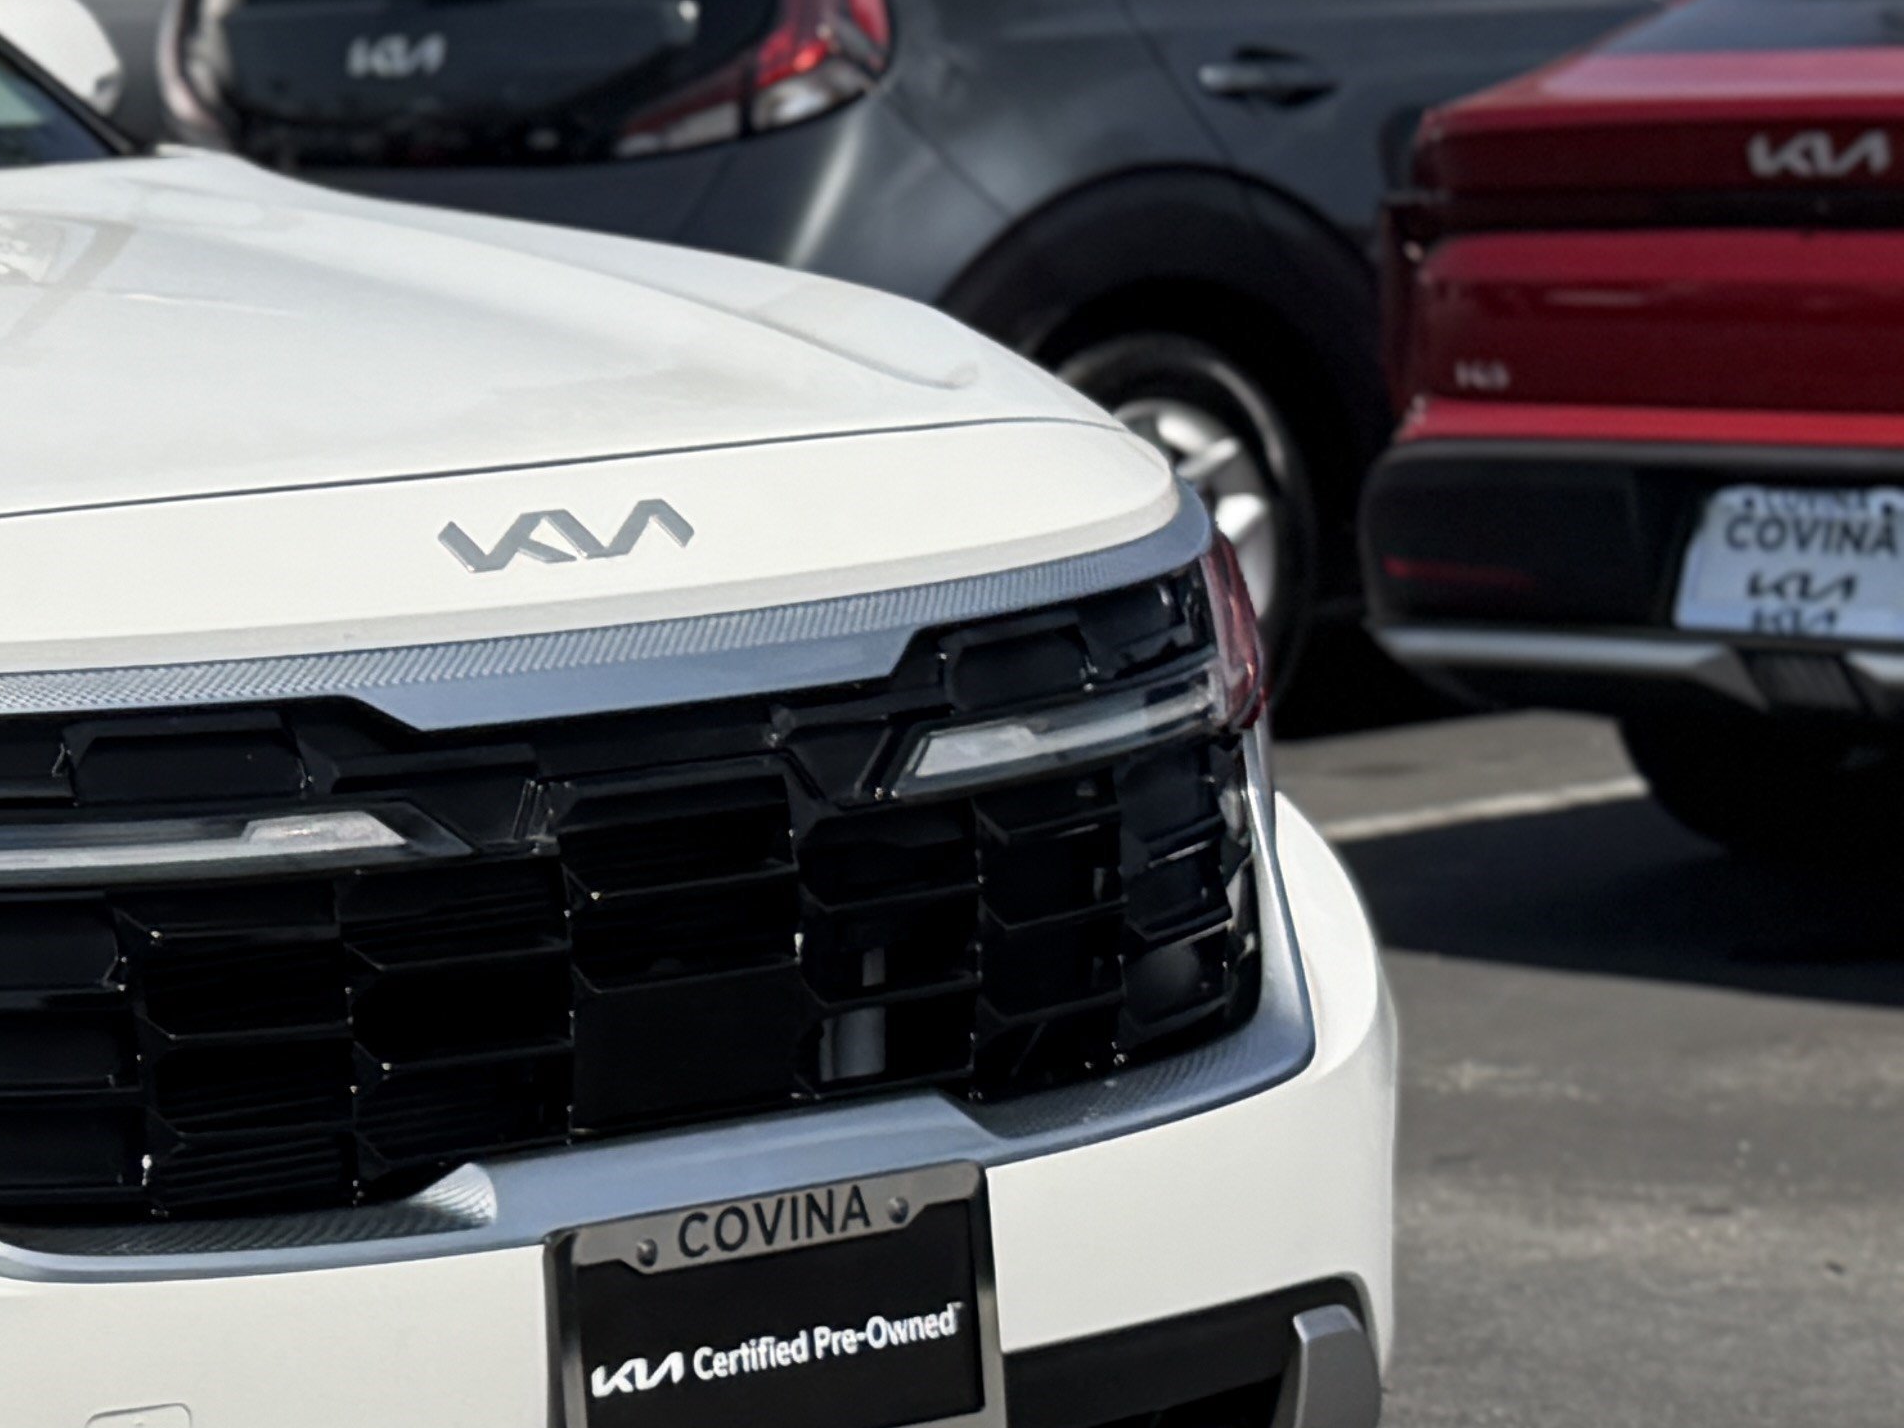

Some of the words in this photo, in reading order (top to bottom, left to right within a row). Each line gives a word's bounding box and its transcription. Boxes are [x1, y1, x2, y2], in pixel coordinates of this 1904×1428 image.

[347, 33, 447, 77] KIA
[1747, 129, 1891, 178] KIA
[437, 499, 694, 573] KIA
[1725, 515, 1898, 556] COVINA
[1748, 570, 1857, 602] KIA
[678, 1185, 871, 1258] COVINA
[591, 1352, 684, 1398] KIA
[693, 1332, 809, 1380] Certified
[814, 1303, 958, 1360] Pre-Owned
